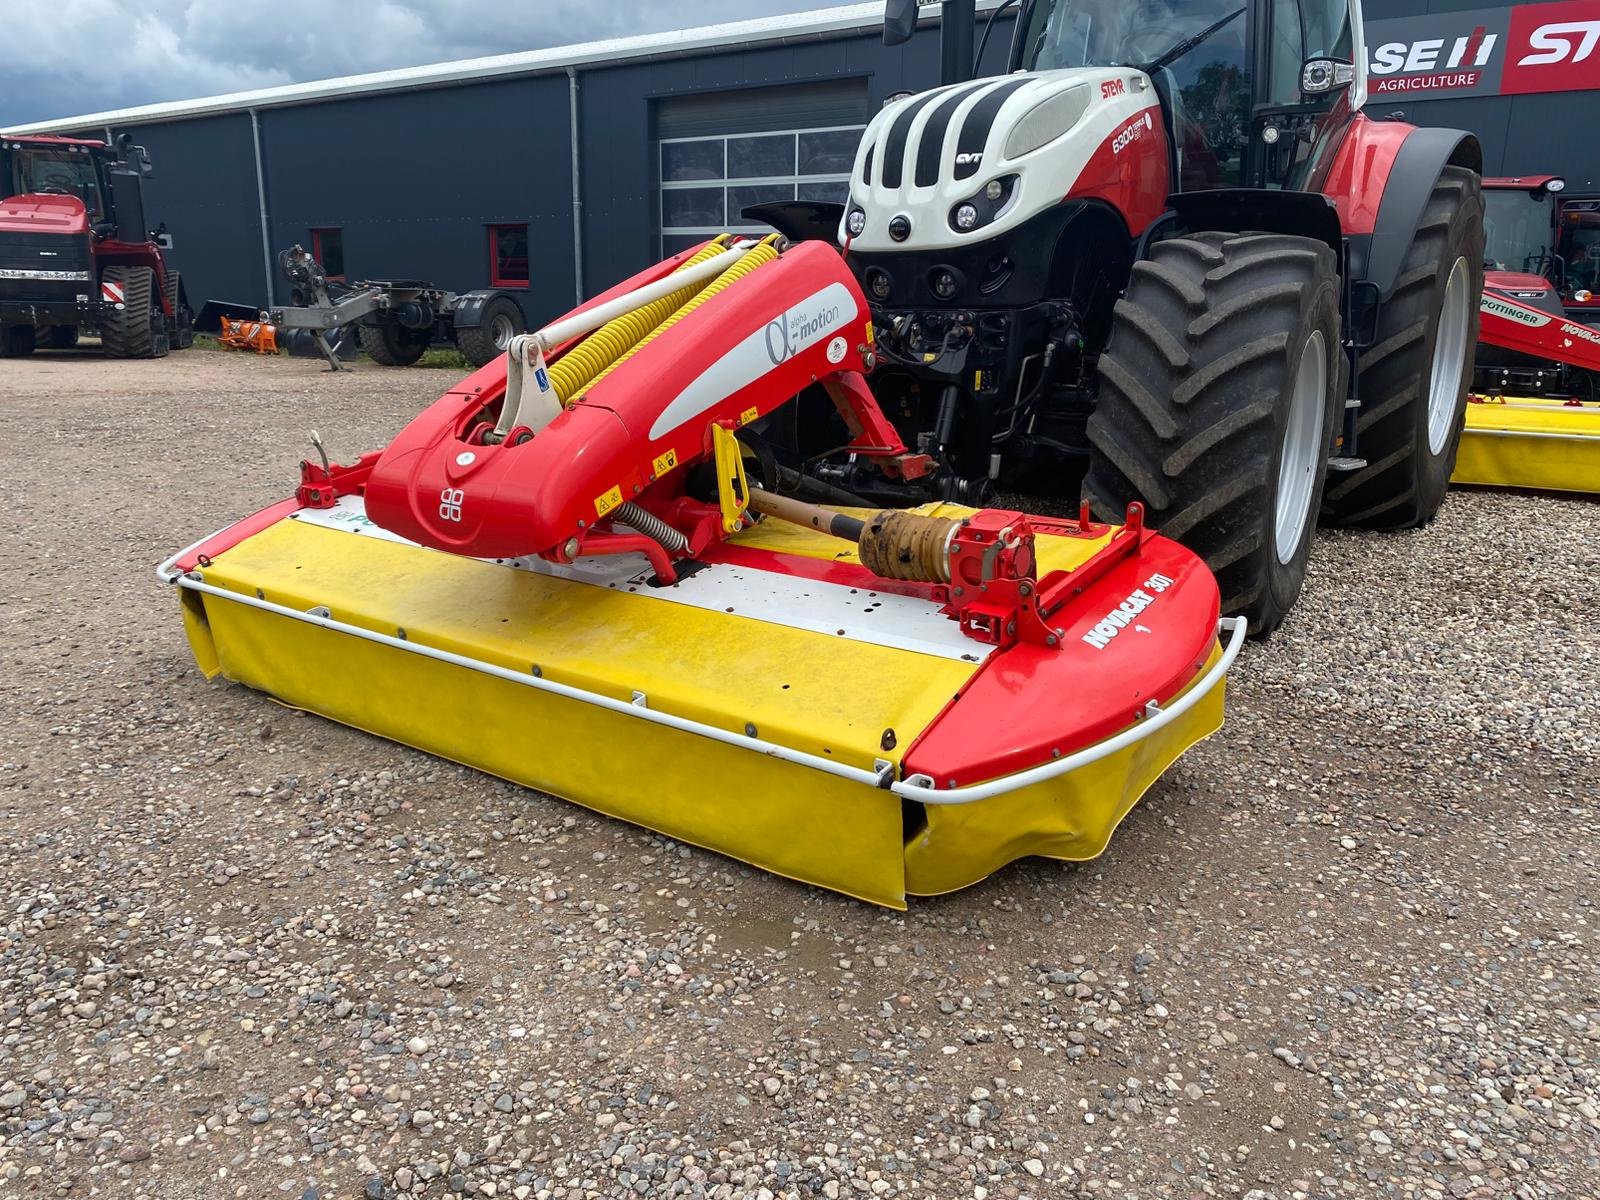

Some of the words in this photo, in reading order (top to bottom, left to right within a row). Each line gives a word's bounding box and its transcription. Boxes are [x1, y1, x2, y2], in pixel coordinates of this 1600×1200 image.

[1364, 39, 1444, 75] SE
[1101, 78, 1126, 99] STEYR
[1377, 73, 1476, 92] AGRICULTURE
[1112, 125, 1135, 154] 6300
[956, 152, 983, 164] CVT
[1081, 588, 1155, 650] NOVACAT
[1143, 573, 1175, 593] 301
